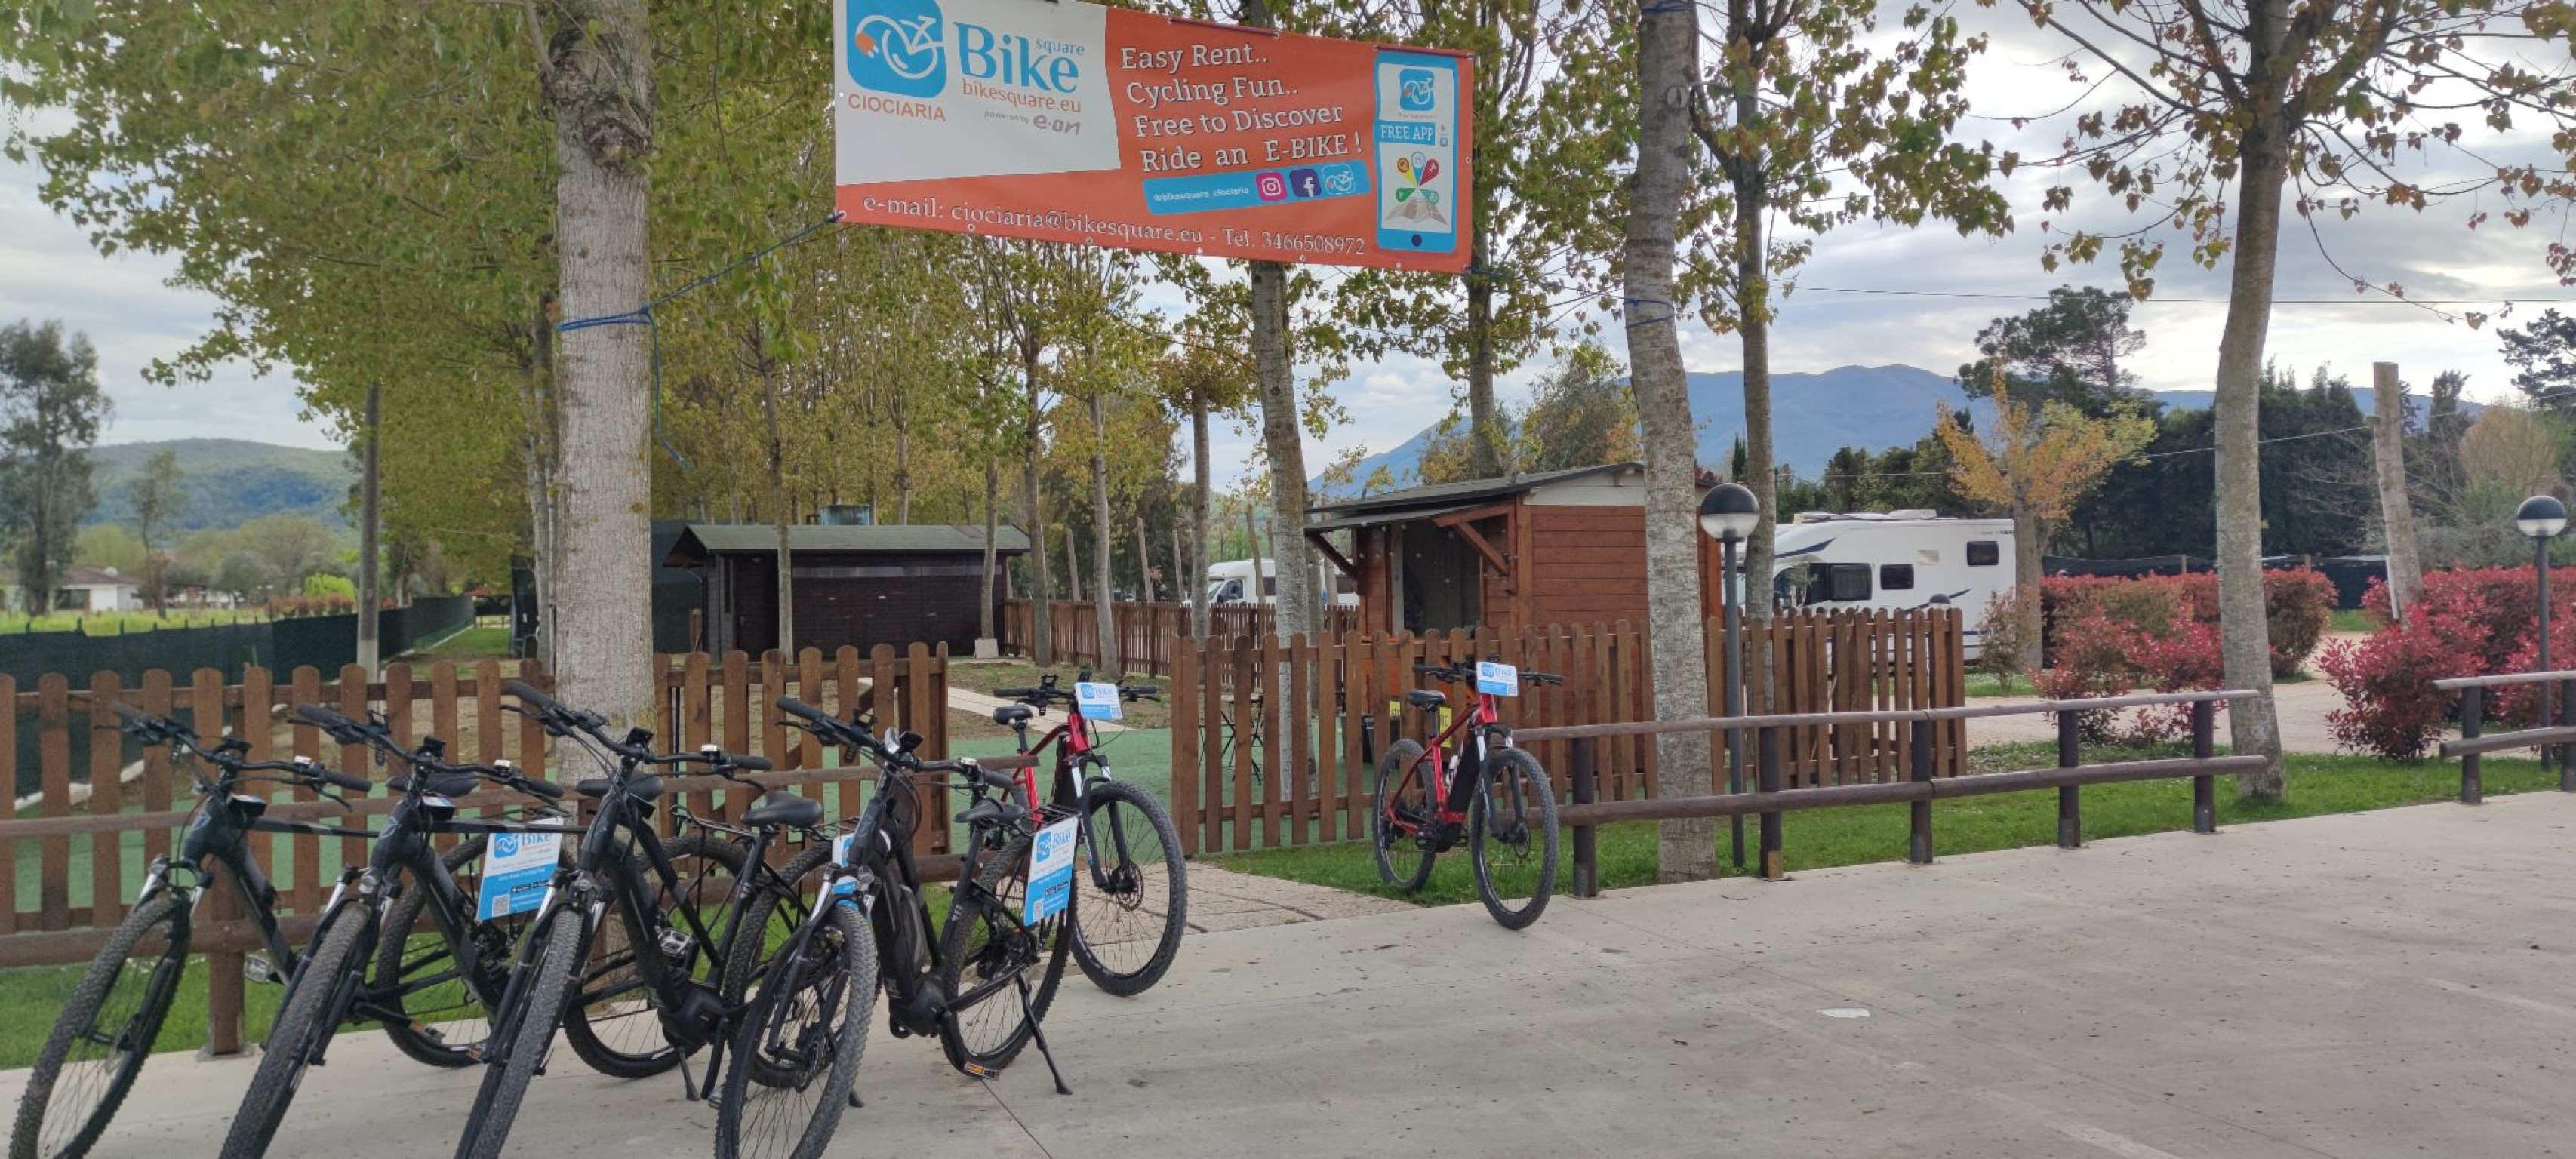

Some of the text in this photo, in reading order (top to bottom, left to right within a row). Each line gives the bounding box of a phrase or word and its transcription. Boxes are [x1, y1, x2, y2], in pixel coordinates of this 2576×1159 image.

[953, 22, 1079, 94] Bike
[1035, 38, 1085, 56] square
[1121, 43, 1268, 74] Easy Rent..
[848, 93, 946, 121] CIOCIARIA
[962, 78, 1082, 112] bikesquare.eu
[1126, 76, 1299, 109] Cycling Fun..
[1134, 106, 1343, 137] Free to Discover
[1380, 125, 1434, 141] FREE APP
[1140, 131, 1362, 172] Ride an E-BIKE !
[863, 196, 943, 219] e-mail:
[951, 201, 1203, 243] ciociaria@bikesquare.eu
[1221, 228, 1256, 249] Tel.
[1261, 230, 1365, 255] 3466508972
[1052, 831, 1071, 847] Bike
